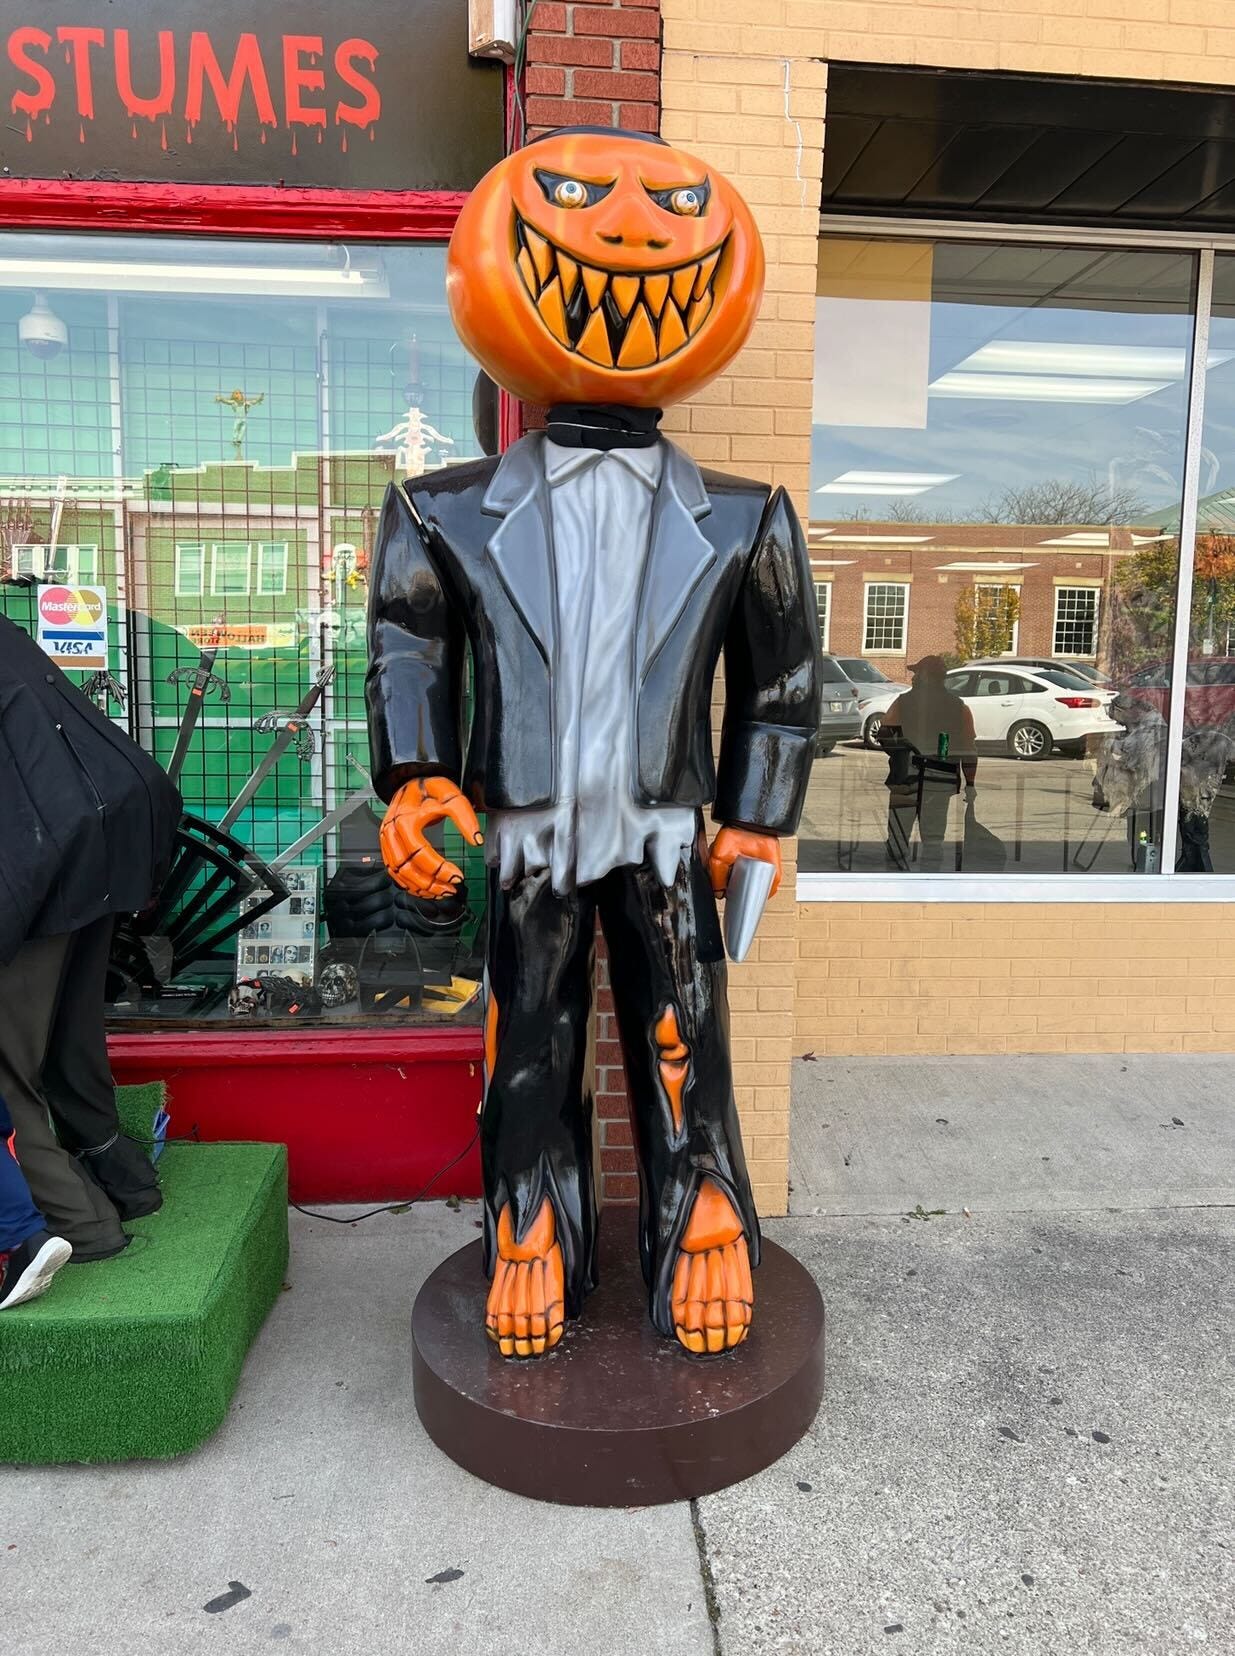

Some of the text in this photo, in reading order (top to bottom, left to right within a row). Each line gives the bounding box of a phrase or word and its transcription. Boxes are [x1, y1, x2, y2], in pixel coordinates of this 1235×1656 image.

[7, 26, 381, 134] STUMES
[41, 600, 102, 612] Masterard
[53, 641, 93, 655] VISA
